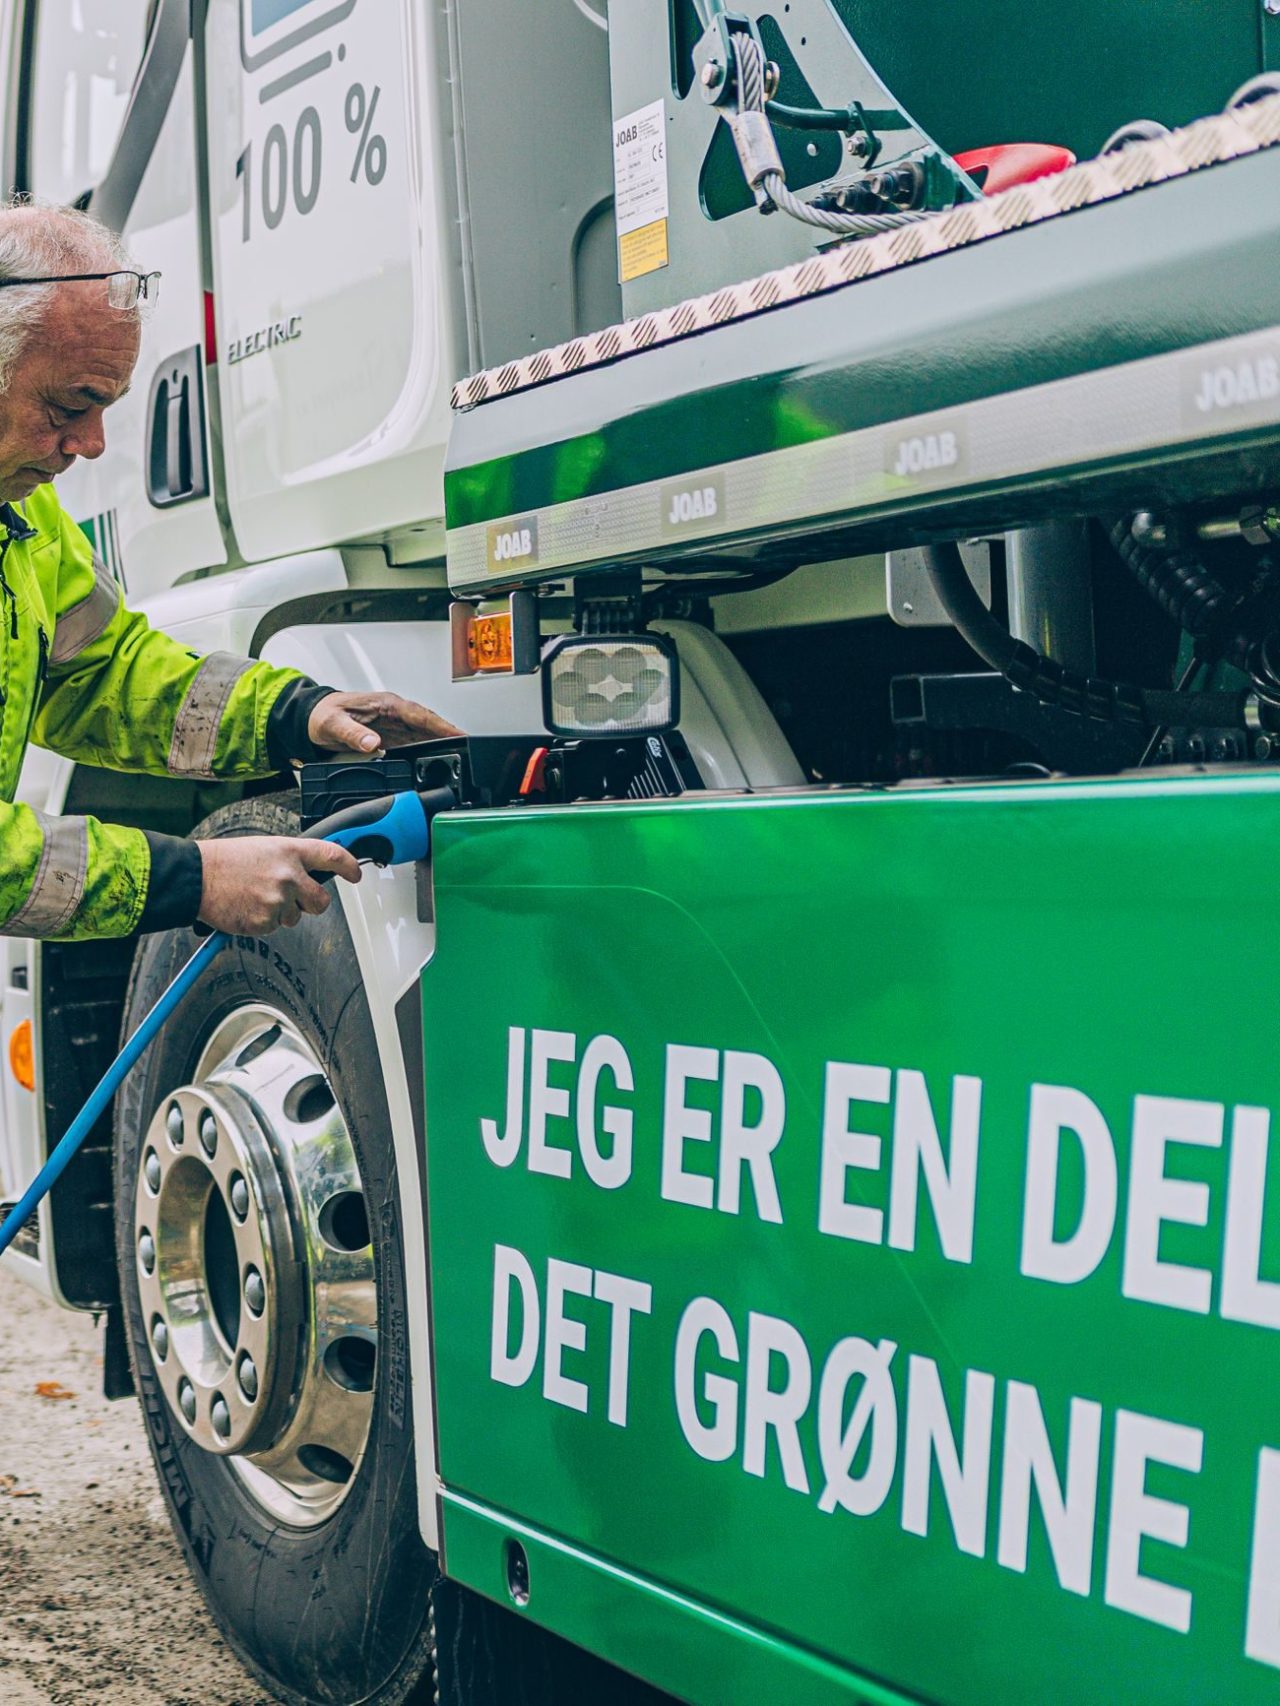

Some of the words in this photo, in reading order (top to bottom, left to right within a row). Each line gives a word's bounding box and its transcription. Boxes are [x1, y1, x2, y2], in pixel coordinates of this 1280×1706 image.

[616, 125, 638, 148] JOAB
[236, 106, 322, 243] 100
[344, 82, 387, 186] %
[227, 315, 302, 365] ELECTRIC
[1195, 356, 1280, 412] JOAB
[895, 431, 958, 476] JOAB
[669, 487, 717, 524] JOAB
[494, 529, 532, 561] JOAB
[481, 1026, 634, 1189] JEG
[661, 1044, 785, 1224] ER
[818, 1061, 982, 1264] EN
[1021, 1083, 1280, 1329] DEL
[491, 1244, 652, 1427] DET
[674, 1297, 1203, 1632] GRØNNE
